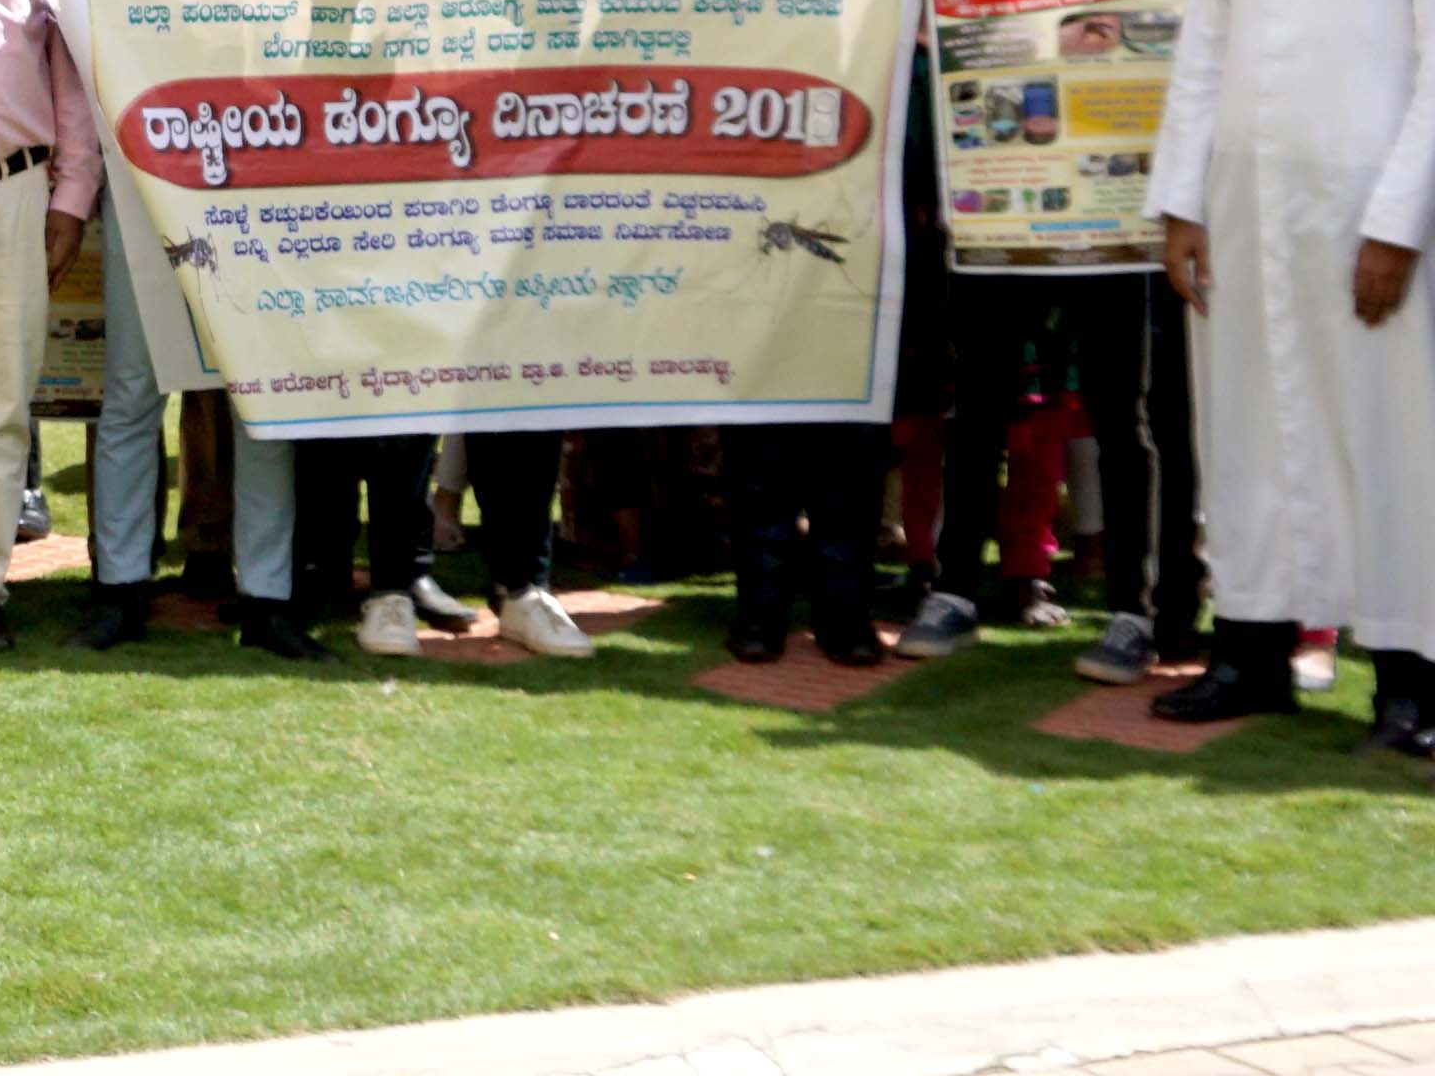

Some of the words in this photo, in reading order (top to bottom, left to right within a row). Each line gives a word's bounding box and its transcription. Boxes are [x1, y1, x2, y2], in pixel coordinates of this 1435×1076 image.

[127, 3, 171, 34] ಜಿಲ್ಲಾ
[387, 0, 430, 31] ಜಿಲ್ಲಾ
[263, 32, 372, 59] ಬೆಂಗಳೂರು
[382, 36, 430, 59] ನಗರ
[141, 89, 303, 185] ರಾಷ್ಟ್ರೀಯ
[323, 84, 473, 170] ಡೆಂಗ್ಯೂ
[492, 77, 691, 140] ದಿನಾಚರಣೆ
[204, 203, 251, 235] ಸೊಳ್ಳೆ
[277, 234, 343, 261] ಎಲ್ಲರೂ
[353, 230, 396, 252] ಸೇರಿ
[407, 228, 482, 257] ಡೆಂಗ್ಯೂ
